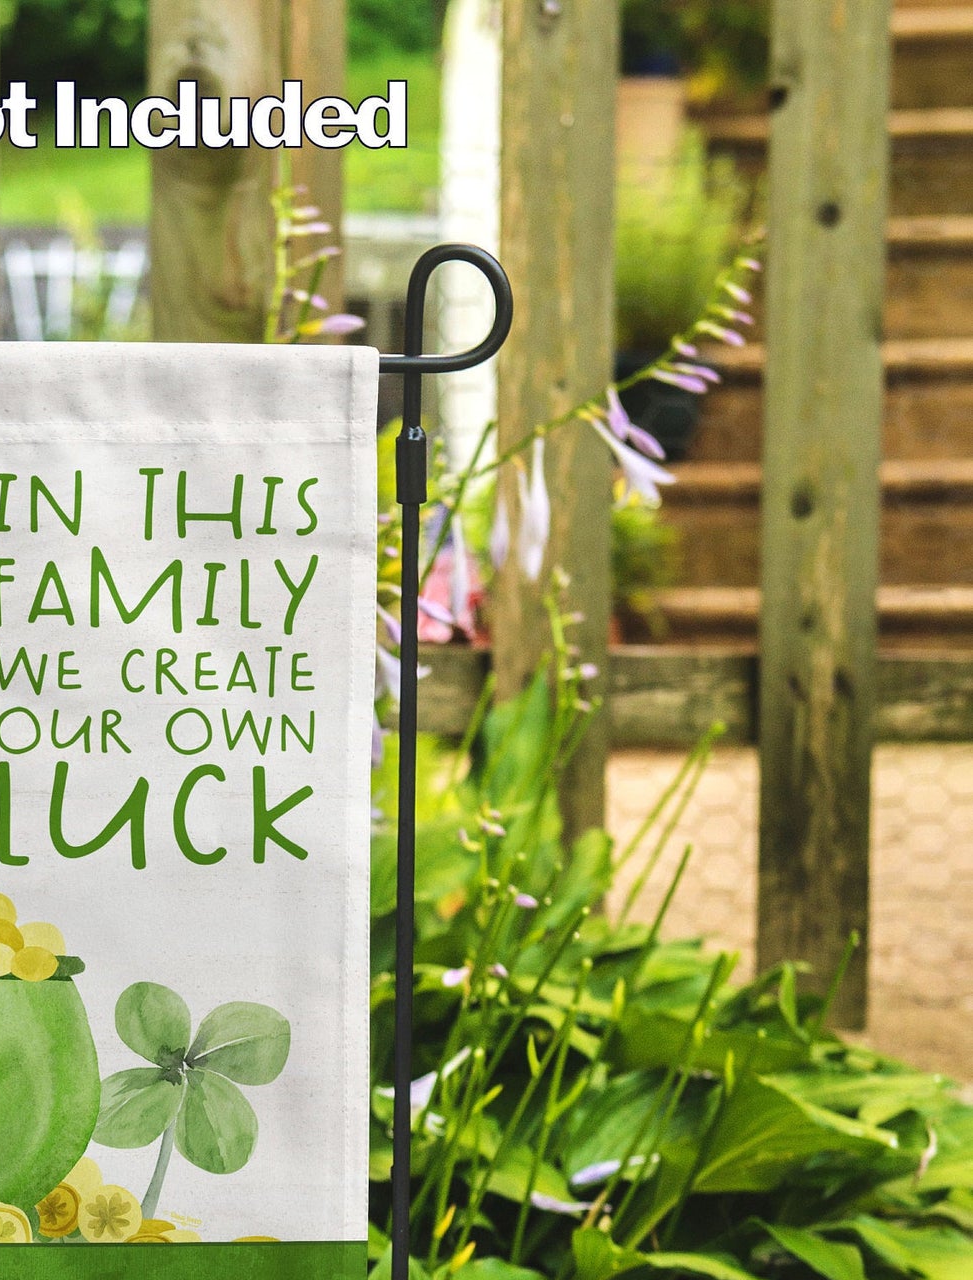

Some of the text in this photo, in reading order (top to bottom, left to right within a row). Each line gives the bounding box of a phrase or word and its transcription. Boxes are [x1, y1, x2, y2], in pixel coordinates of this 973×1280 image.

[138, 466, 319, 540] THIS
[120, 646, 316, 698] CREATE
[165, 707, 316, 756] OWN
